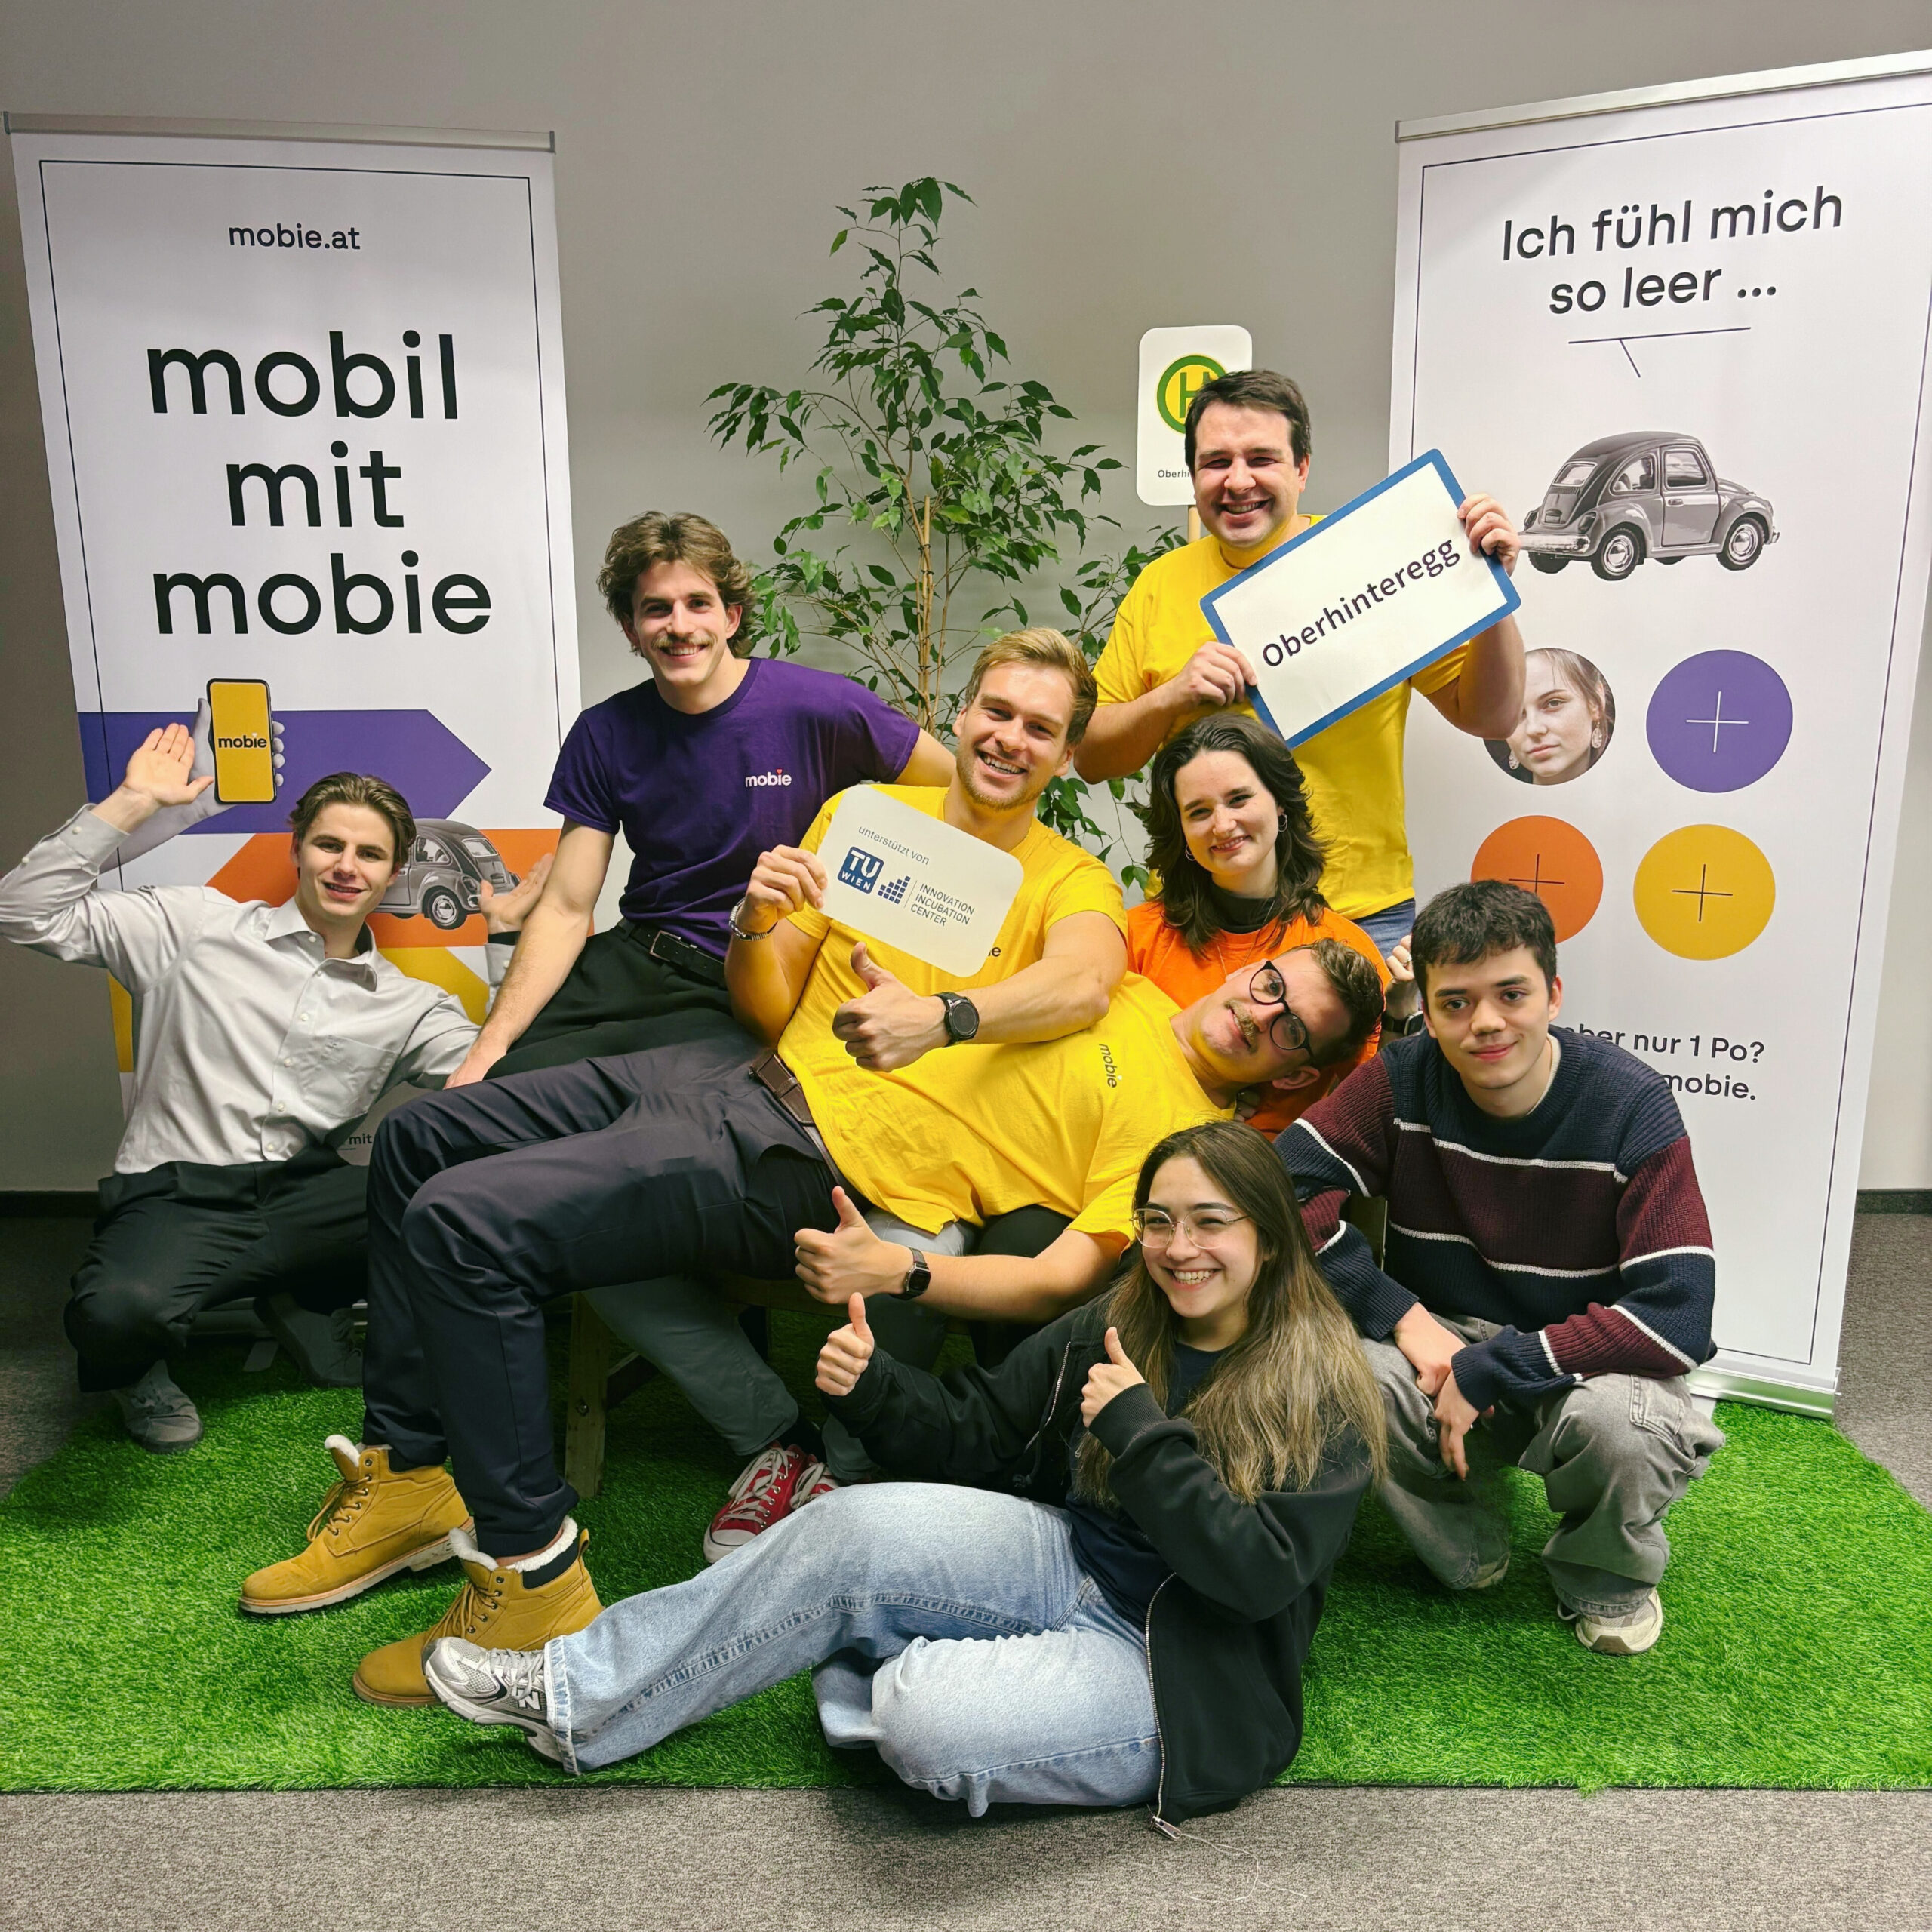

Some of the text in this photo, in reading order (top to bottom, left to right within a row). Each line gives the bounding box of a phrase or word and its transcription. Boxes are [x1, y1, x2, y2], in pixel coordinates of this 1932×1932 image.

[229, 223, 361, 250] mobie.at
[1503, 185, 1842, 261] Ich fühl mich
[1549, 281, 1607, 315] so
[1623, 266, 1722, 309] leer
[146, 329, 458, 420] mobil
[226, 440, 405, 528] mit
[152, 549, 491, 635] mobie
[1262, 539, 1460, 667] Oberhinteregg
[217, 733, 268, 748] mobie
[745, 768, 792, 787] mobie
[850, 850, 881, 878] TU
[858, 826, 930, 866] unterstützt von
[841, 870, 872, 891] WIEN
[910, 903, 947, 926] CENTER
[915, 894, 971, 925] INCUBATION
[919, 883, 975, 915] INNOVATION
[1564, 1023, 1765, 1063] ber nur 1 Po?
[1098, 1043, 1123, 1088] mobie
[349, 1133, 373, 1145] mit
